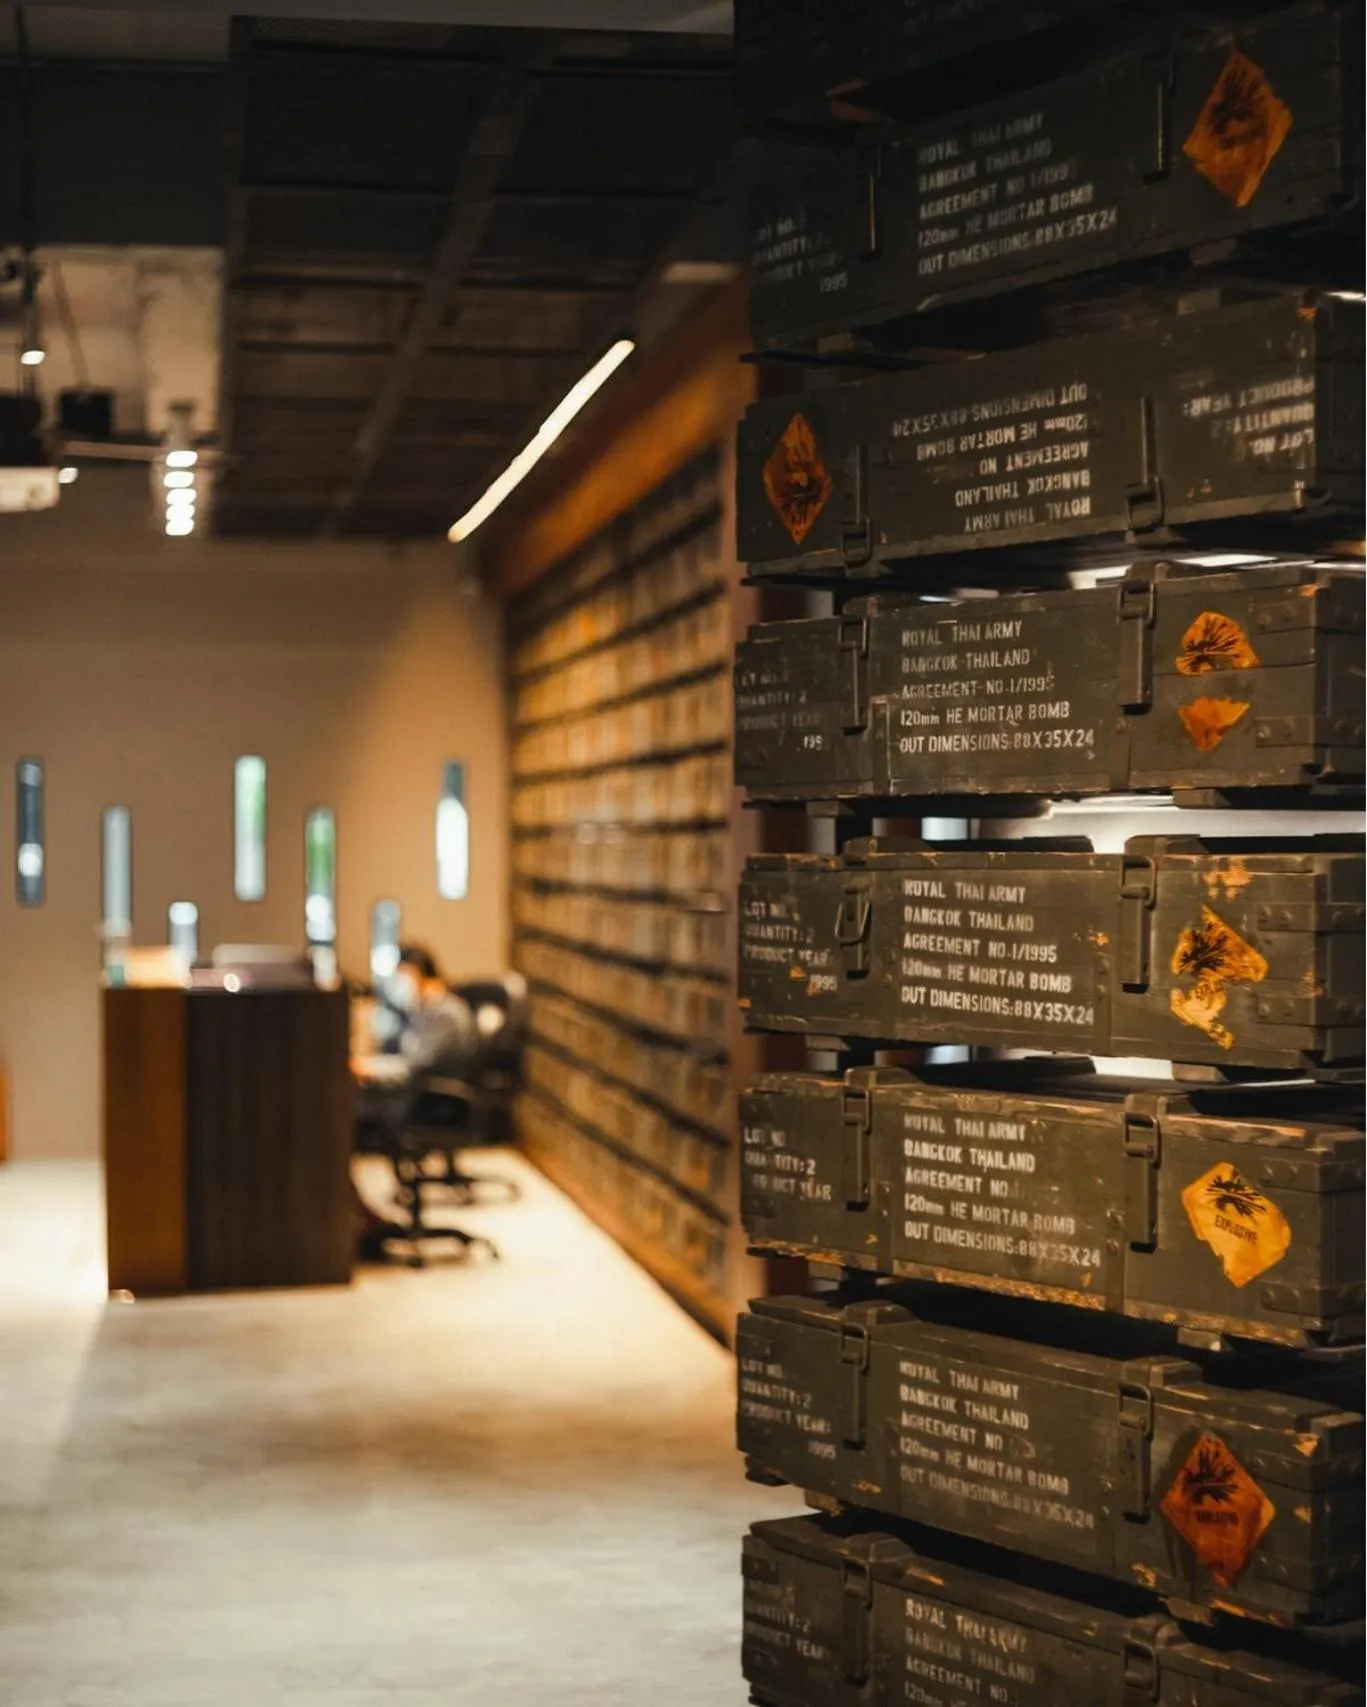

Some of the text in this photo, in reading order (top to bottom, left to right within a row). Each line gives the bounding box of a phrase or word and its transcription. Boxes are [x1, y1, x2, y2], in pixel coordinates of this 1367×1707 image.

[918, 160, 978, 194] BANGKOK
[917, 227, 960, 249] 120mm
[987, 197, 1045, 230] MORTAR
[1049, 181, 1095, 214] BOMB
[918, 182, 999, 222] AGREEMENT
[917, 252, 945, 278] OUT
[1059, 382, 1088, 405] OUT
[916, 412, 1088, 461] 120mm HE MORTAR BOMB
[1279, 427, 1315, 452] LOT
[1005, 440, 1090, 472] AGREEMENT
[954, 468, 1091, 507] BANGKOK THAILAND
[964, 496, 1091, 534] ROYAL THAI ARMY
[901, 620, 1023, 647] ROYAL THAI ARMY
[901, 648, 1031, 674] BANGKOK THAILAND
[901, 680, 978, 700] AGREEMENT
[900, 700, 1071, 727] 120mm HE MORTAR BOMB
[899, 735, 925, 753] OUT
[904, 879, 1026, 903] ROYAL THAI ARMY
[904, 905, 1034, 932] BANGKOK THAILAND
[904, 932, 980, 956] AGREEMENT
[902, 957, 1072, 993] 120mm HE MORTAR BOMB
[901, 986, 927, 1005] OUT
[904, 1113, 1026, 1141] ROYAL THAI ARMY
[904, 1139, 1036, 1172] BANGKOK THAILAND
[905, 1167, 983, 1195] AGREEMENT
[904, 1193, 1076, 1235] 120mm HE MORTAR BOMB
[905, 1221, 930, 1240] OUT
[900, 1361, 1019, 1401] ROYAL THAI ARMY
[900, 1384, 1029, 1430] BANGKOK THAILAND
[901, 1411, 976, 1445] AGREEMENT
[900, 1436, 1069, 1495] 120mm HE MORTAR BOMB
[900, 1465, 924, 1484] OUT
[905, 1598, 947, 1630] ROYAL
[905, 1624, 1036, 1684] BANGKOK THAILAND
[905, 1655, 981, 1695] AGREEMENT
